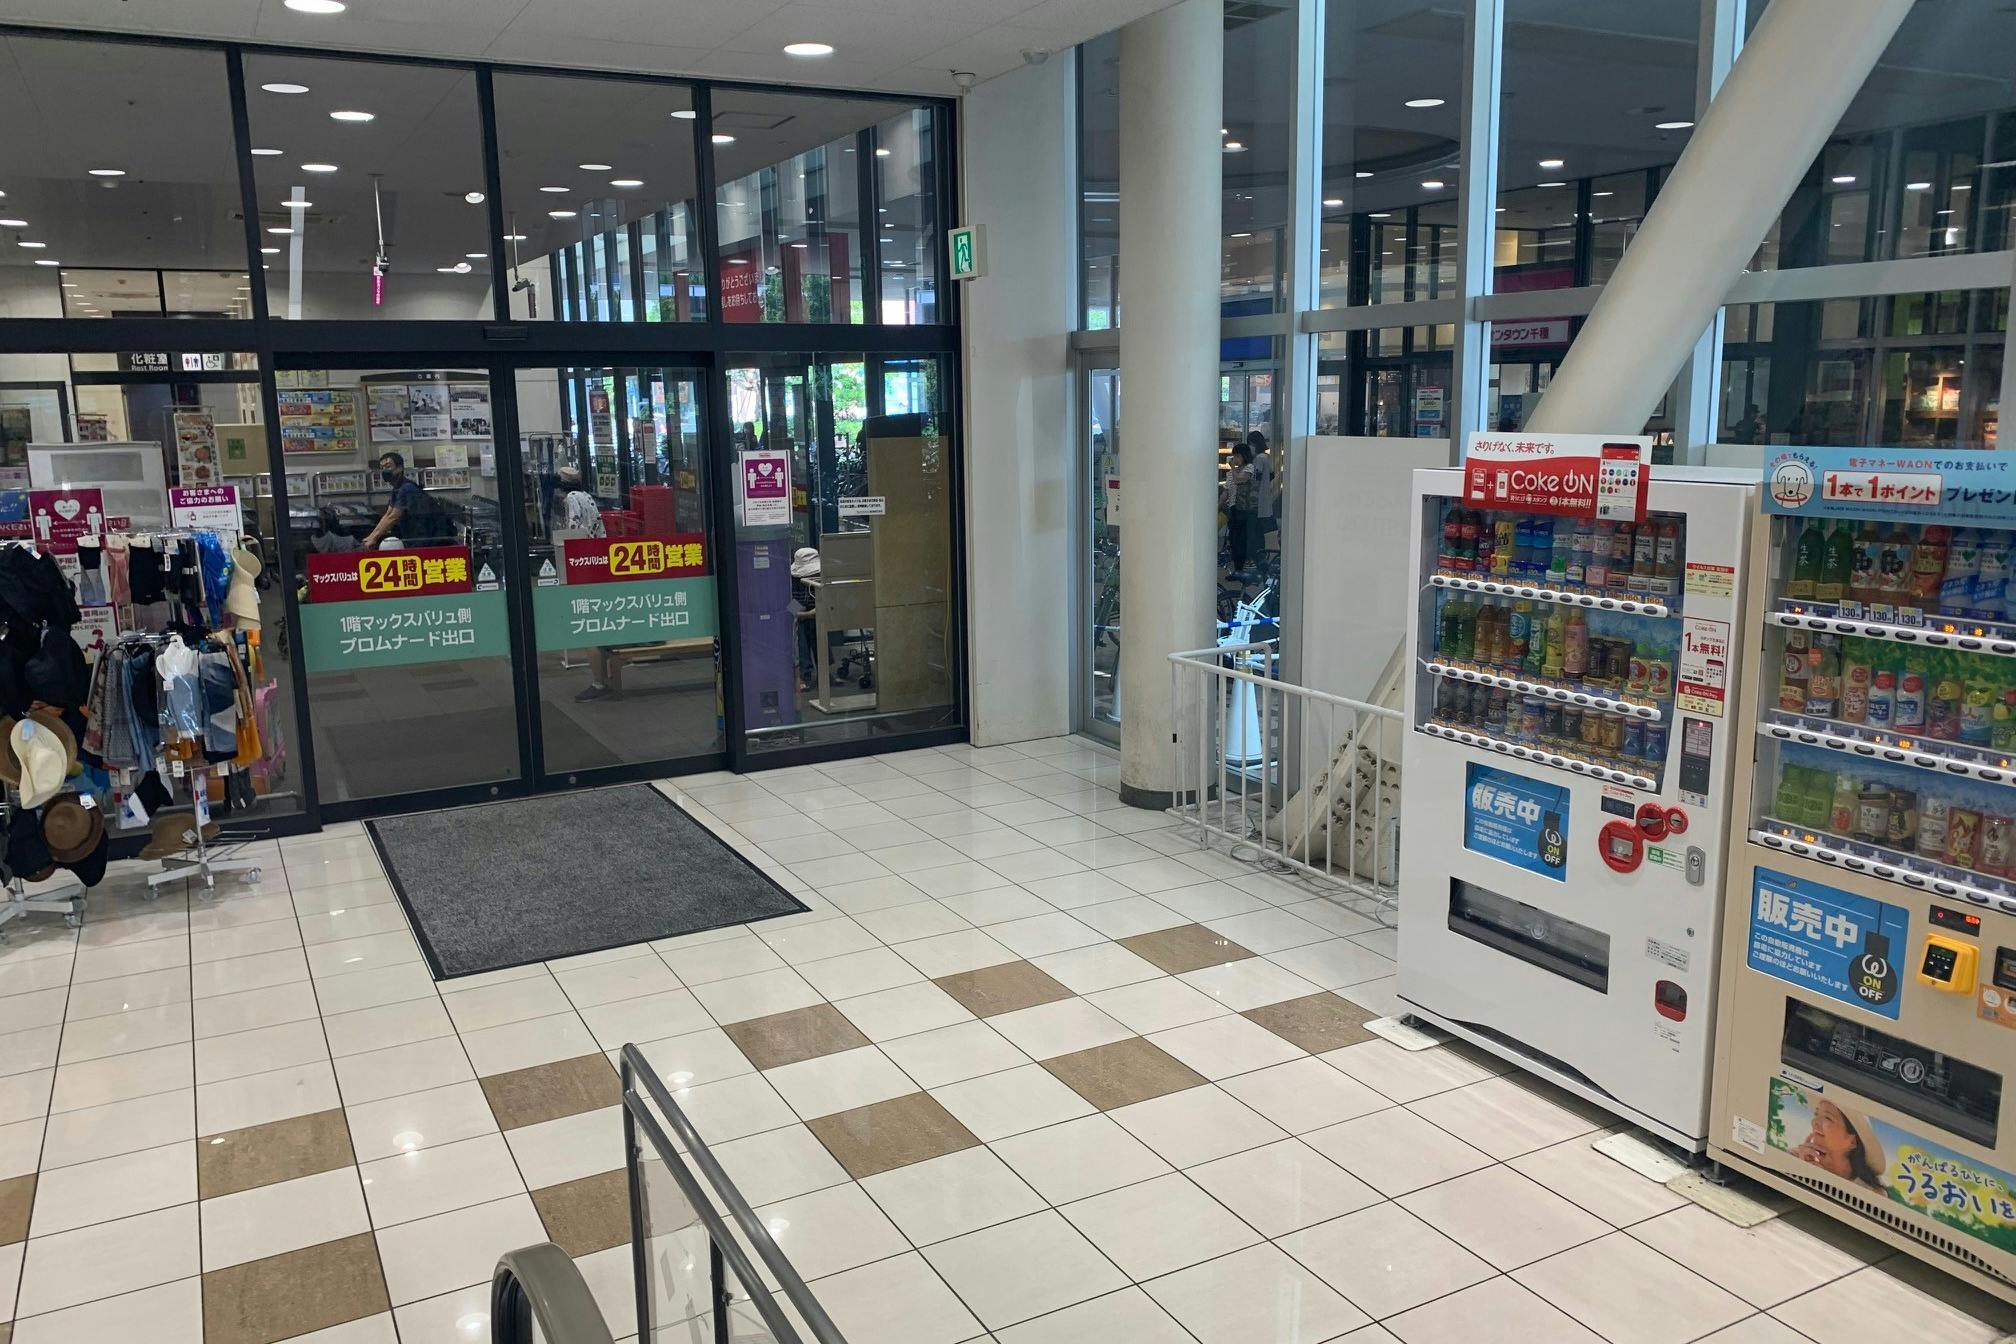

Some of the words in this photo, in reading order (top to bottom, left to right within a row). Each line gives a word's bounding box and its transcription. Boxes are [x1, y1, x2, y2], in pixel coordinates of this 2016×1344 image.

[131, 353, 168, 365] 化粧室
[1475, 440, 1556, 455] さりげなく、未来です。
[1849, 457, 2008, 472] 電子マネーWAONでのお支払いで
[182, 488, 224, 497] お客さまへの
[1511, 470, 1559, 492] Coke
[1563, 469, 1594, 494] ON
[180, 495, 229, 505] ご協力のお願い
[1799, 543, 1809, 566] 生茶
[1827, 545, 1838, 568] 生茶
[571, 592, 687, 614] 1階マックスバリュ側
[340, 608, 472, 633] 1階マックスバリュ側
[571, 612, 689, 634] プロムナード出口
[341, 629, 475, 655] プロムナード出口
[1472, 783, 1541, 825] 販売中
[1544, 854, 1561, 865] OFF
[1547, 845, 1560, 855] ON
[1757, 888, 1858, 949] 販売中
[1754, 932, 1810, 957] この自動販売機は
[1858, 986, 1883, 1001] OFF
[1863, 975, 1883, 990] ON
[1908, 1153, 2004, 1192] がんばるひとに、
